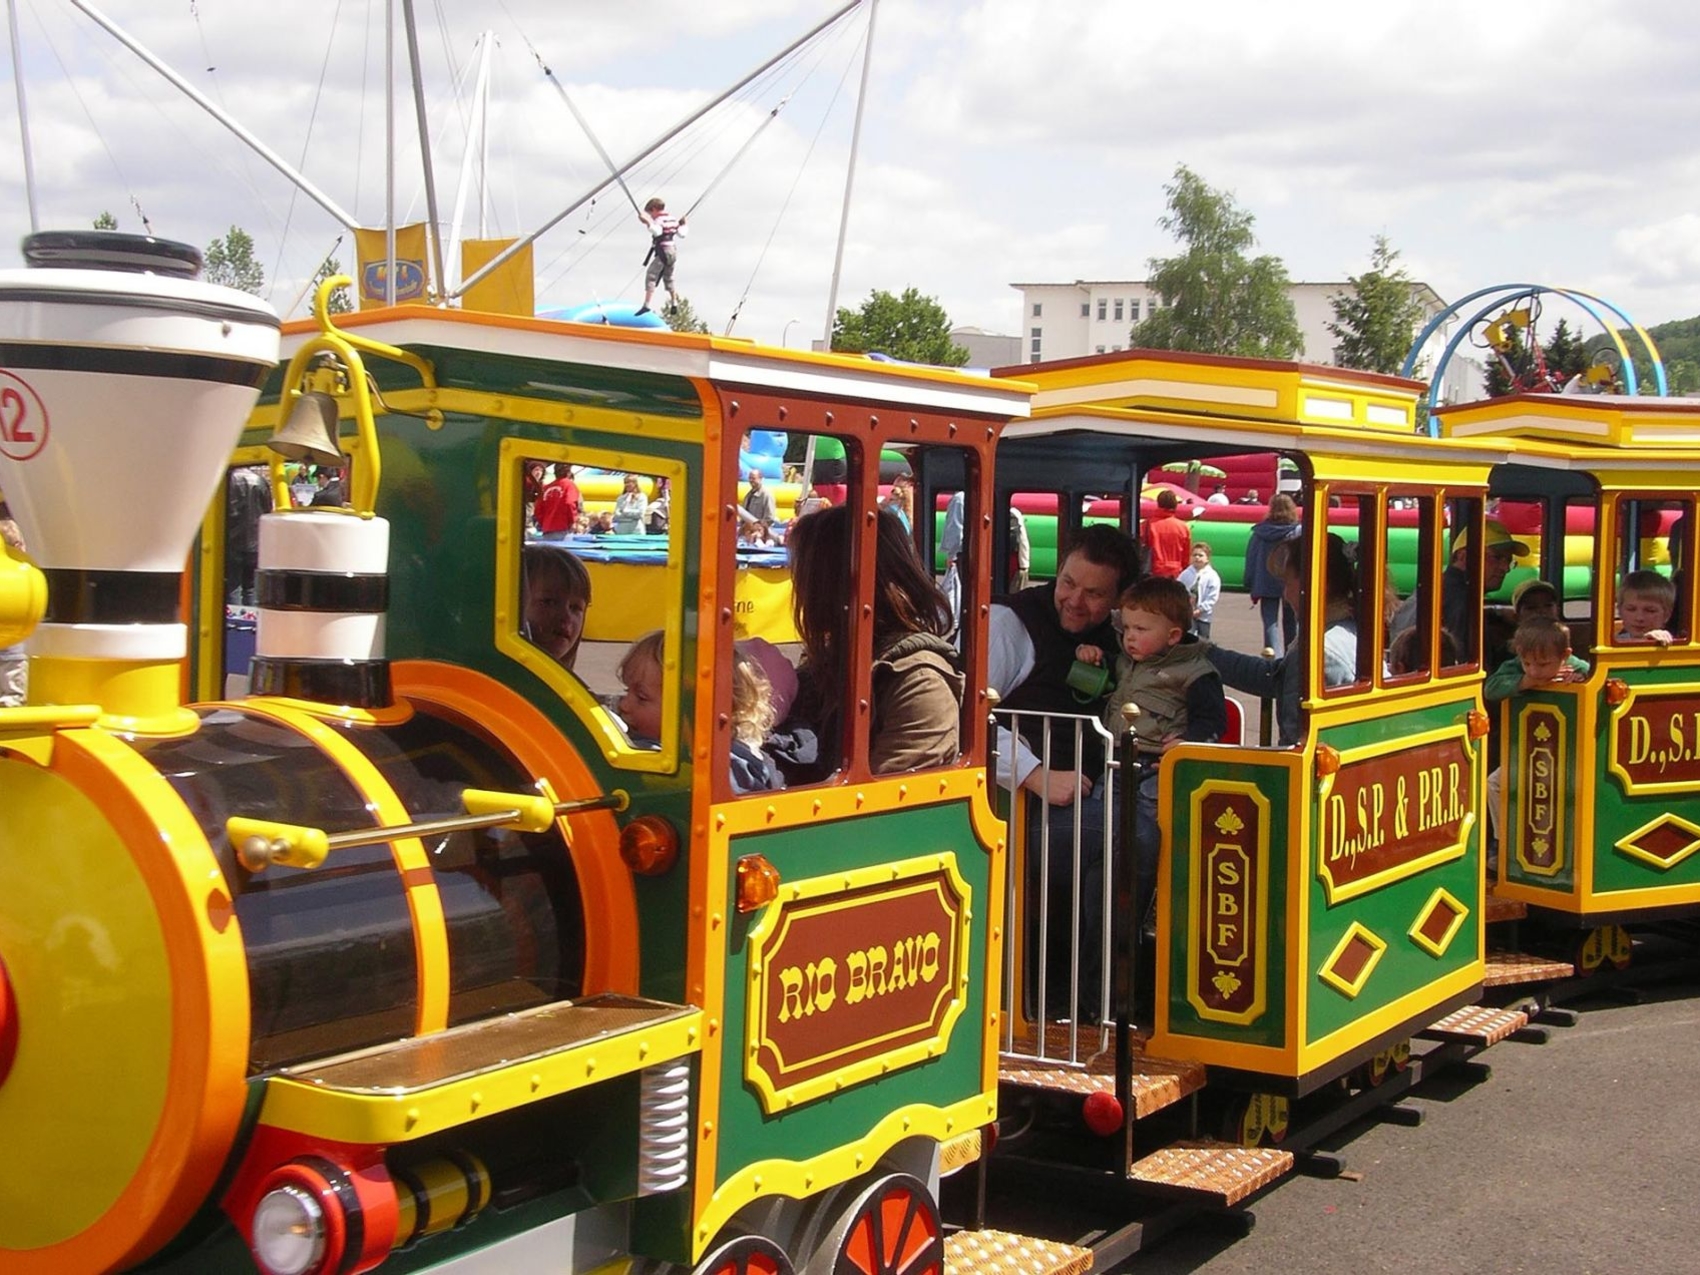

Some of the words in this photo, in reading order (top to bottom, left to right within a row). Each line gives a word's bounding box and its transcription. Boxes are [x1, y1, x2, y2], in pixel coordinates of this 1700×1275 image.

[0, 387, 36, 442] 2
[1394, 775, 1409, 840] &
[1418, 762, 1464, 832] P.R.R.
[1217, 861, 1240, 947] SBF
[777, 956, 838, 1024] RIO
[844, 930, 941, 1005] BRAVO
